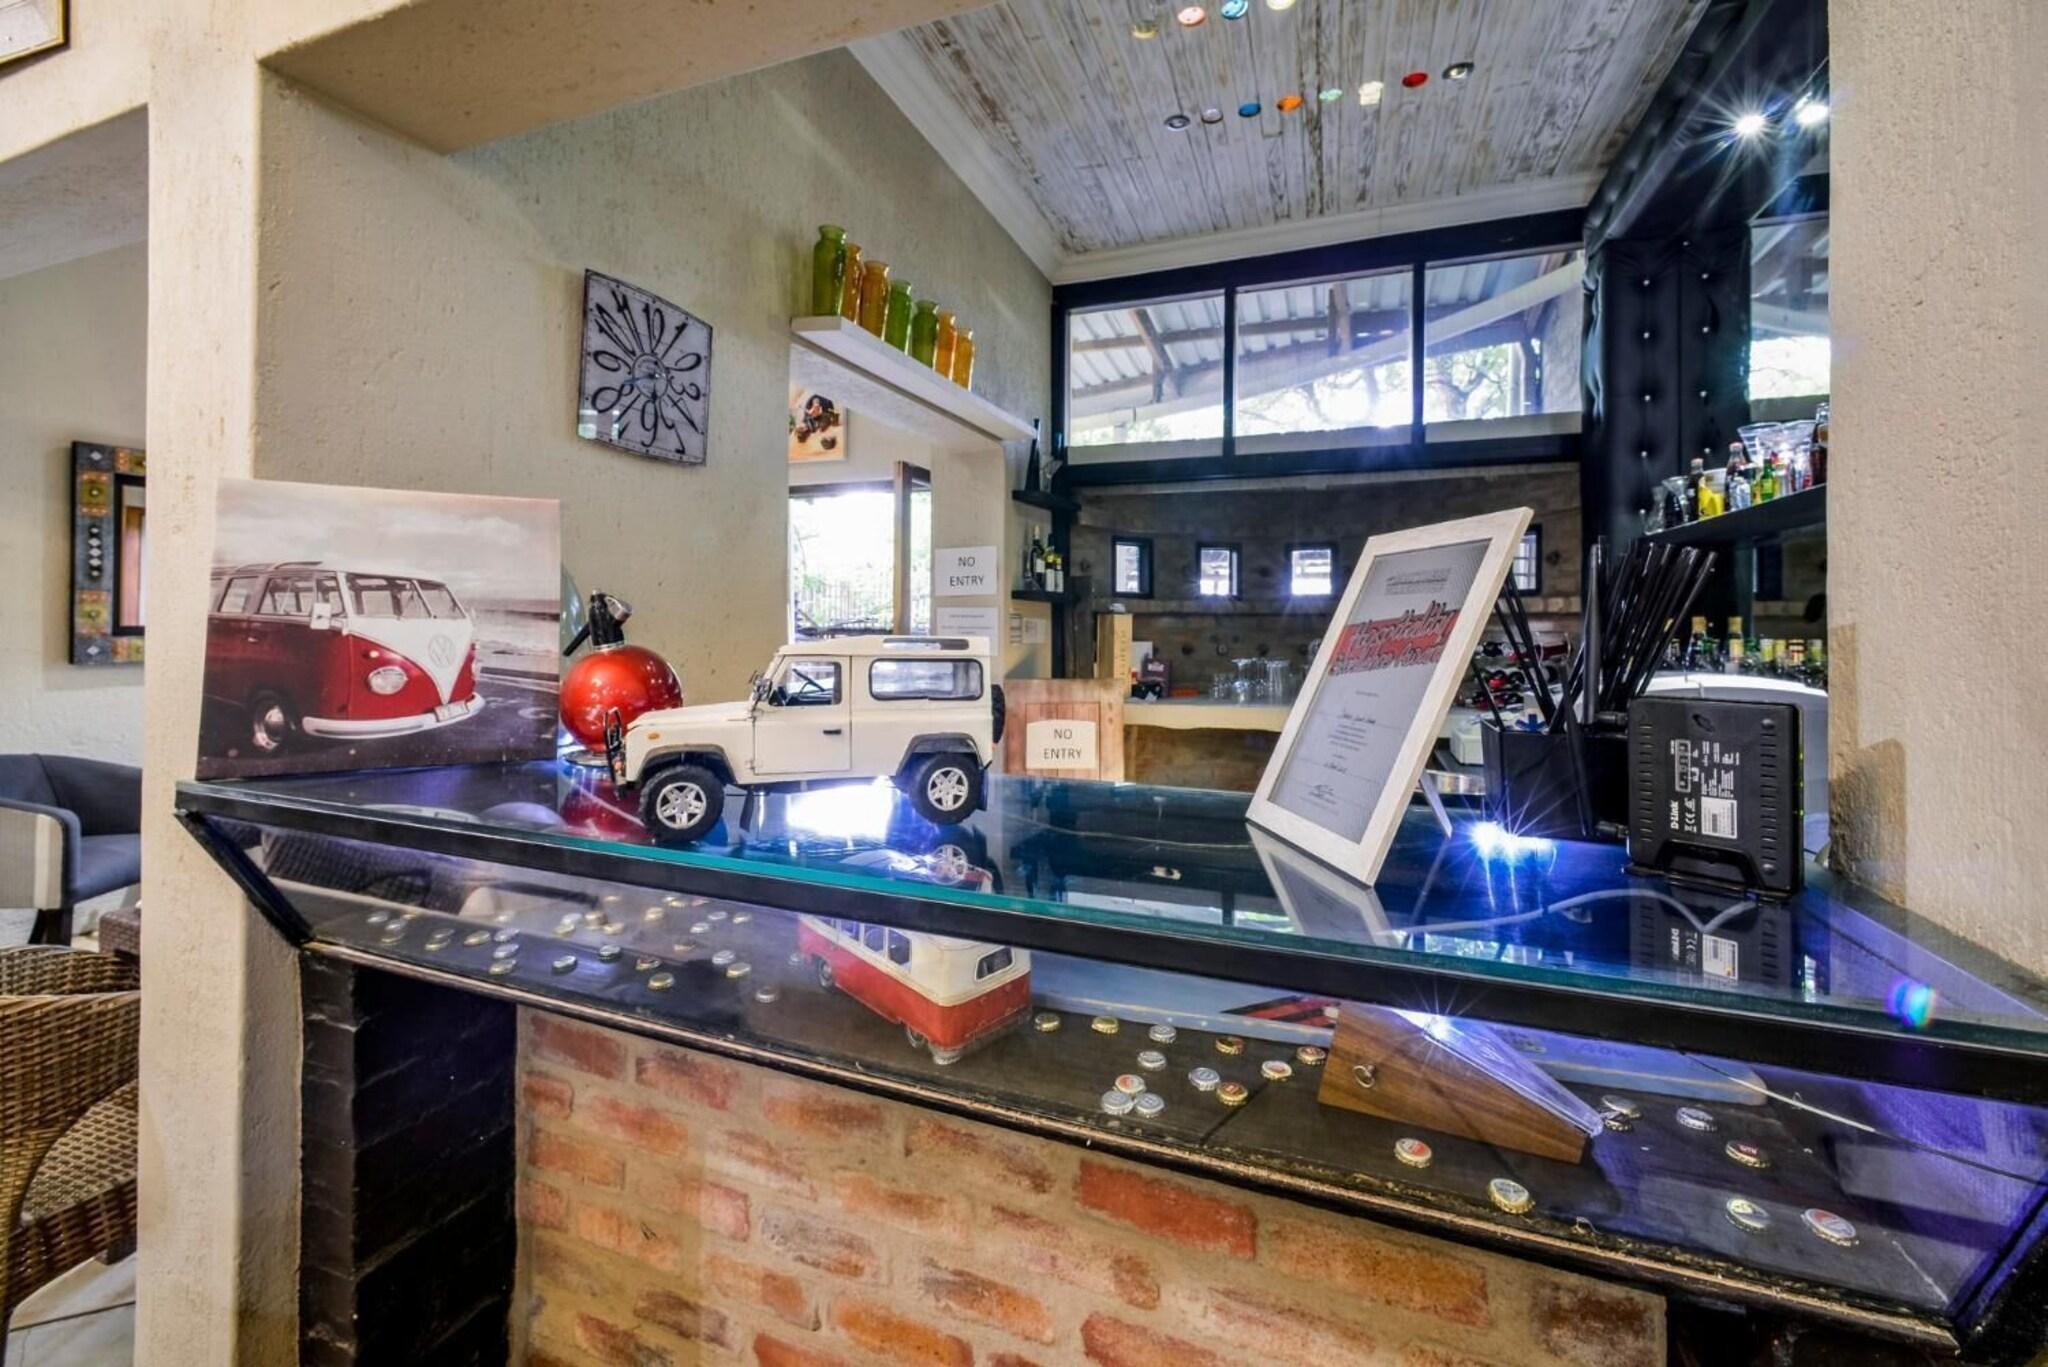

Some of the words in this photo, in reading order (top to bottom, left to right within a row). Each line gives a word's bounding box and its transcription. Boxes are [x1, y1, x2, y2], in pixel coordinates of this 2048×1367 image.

[594, 303, 637, 361] 10
[610, 289, 646, 355] 11
[642, 302, 666, 354] 12
[660, 321, 689, 361] 1
[593, 350, 632, 375] 9
[664, 352, 702, 372] 2
[591, 382, 635, 414] 8
[667, 375, 701, 401] 3
[615, 394, 641, 440] 7
[659, 398, 687, 456] 5
[661, 394, 700, 434] 4
[958, 556, 976, 568] NO
[949, 575, 984, 587] ENTRY
[1054, 728, 1073, 740] NO
[1043, 747, 1082, 760] ENTRY
